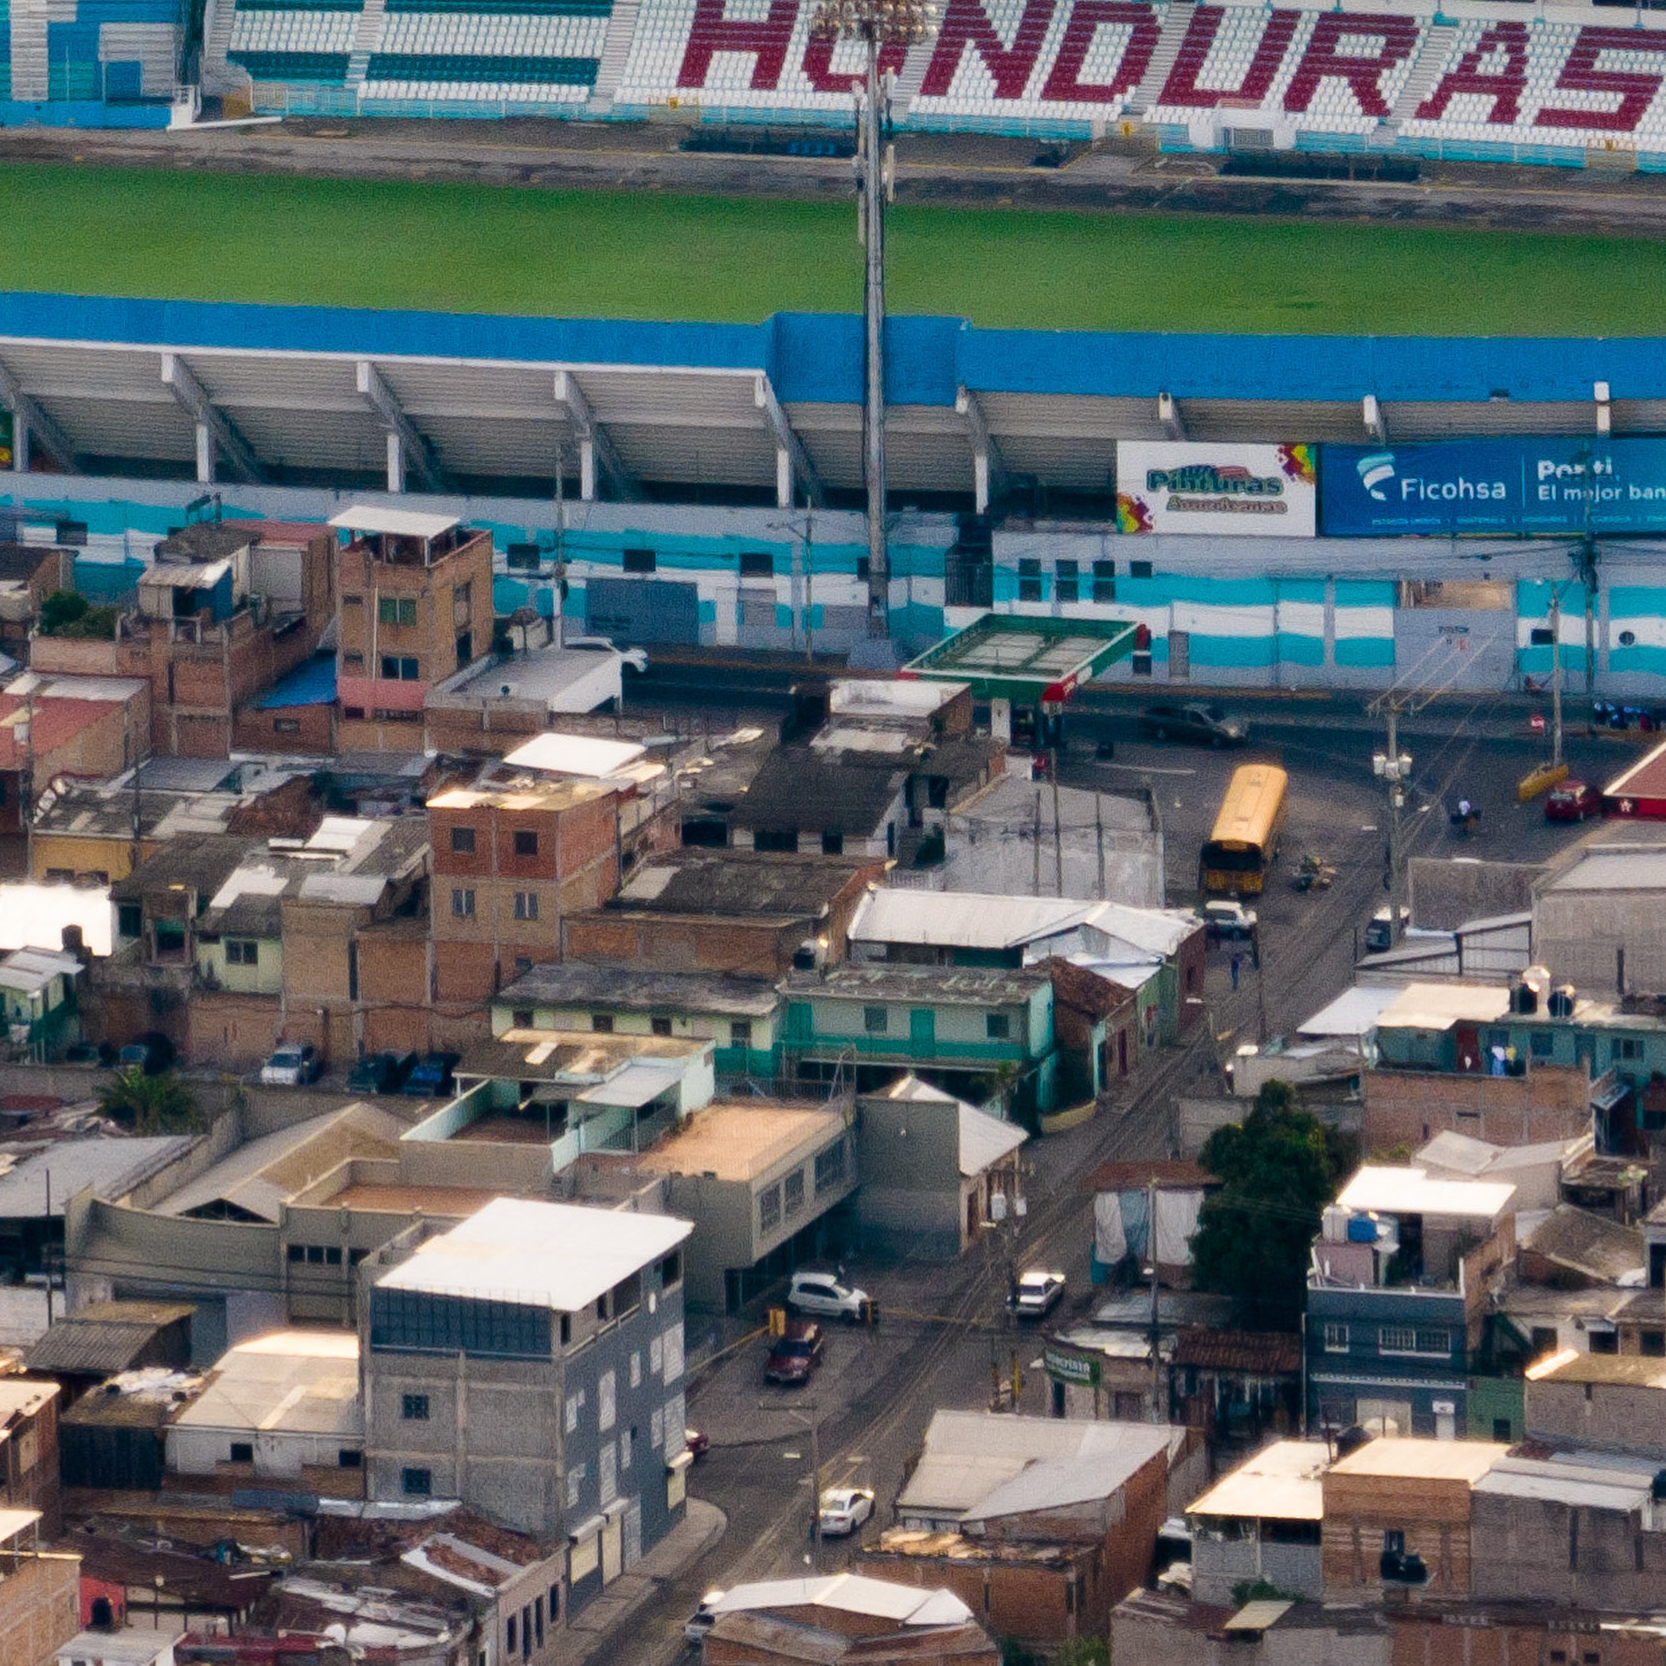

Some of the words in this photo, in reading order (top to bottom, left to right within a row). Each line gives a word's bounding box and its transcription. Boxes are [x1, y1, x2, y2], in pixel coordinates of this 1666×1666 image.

[1147, 467, 1284, 496] Pinturas
[1401, 477, 1507, 502] Ficohsa
[1538, 483, 1556, 501] El
